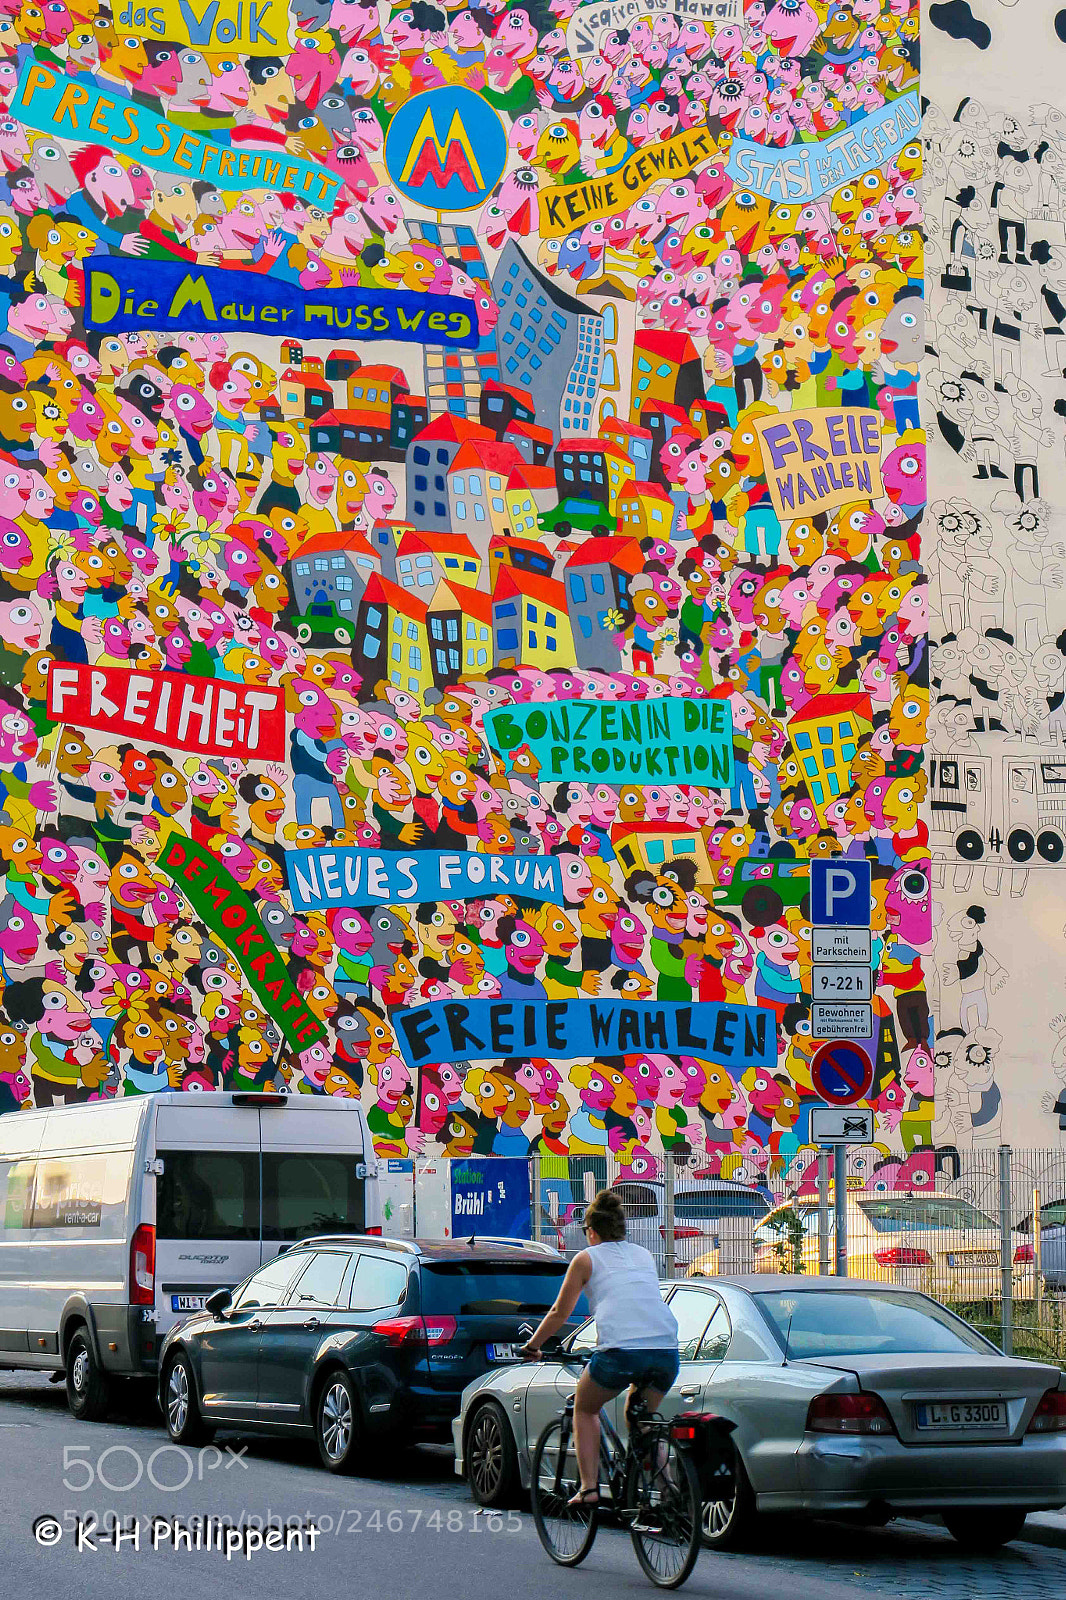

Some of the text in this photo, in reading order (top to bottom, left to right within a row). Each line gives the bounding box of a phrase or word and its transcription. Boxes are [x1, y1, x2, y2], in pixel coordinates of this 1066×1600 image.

[119, 1, 165, 35] das
[674, 0, 737, 18] Hawaii
[21, 65, 338, 200] PRESSEFREIHEIT
[815, 156, 833, 172] IN
[825, 98, 920, 171] TAGEBAU
[545, 133, 707, 229] KEINE GEWALT
[819, 161, 846, 188] DEN
[90, 271, 160, 324] Die
[167, 273, 295, 322] Mauer
[762, 415, 880, 470] FREIE
[776, 460, 873, 512] WAHLEN
[492, 702, 643, 750] BONZEN
[683, 700, 726, 735] DIE
[550, 744, 730, 784] PRODUKTION
[293, 853, 556, 904] NEUES FORUM
[825, 868, 857, 917] P
[166, 842, 321, 1044] DEMOKRATIE
[816, 946, 867, 956] Parkschein
[834, 935, 849, 945] mit
[821, 976, 863, 991] 9-22 h
[817, 1025, 868, 1035] gebührenfrei
[818, 1007, 865, 1017] Bewohner
[399, 1002, 767, 1061] FREIE WAHLEN
[65, 1210, 100, 1224] rent-a-car
[455, 1191, 485, 1216] Brühl
[179, 1297, 192, 1308] WI
[931, 1405, 1000, 1423] L G 3300
